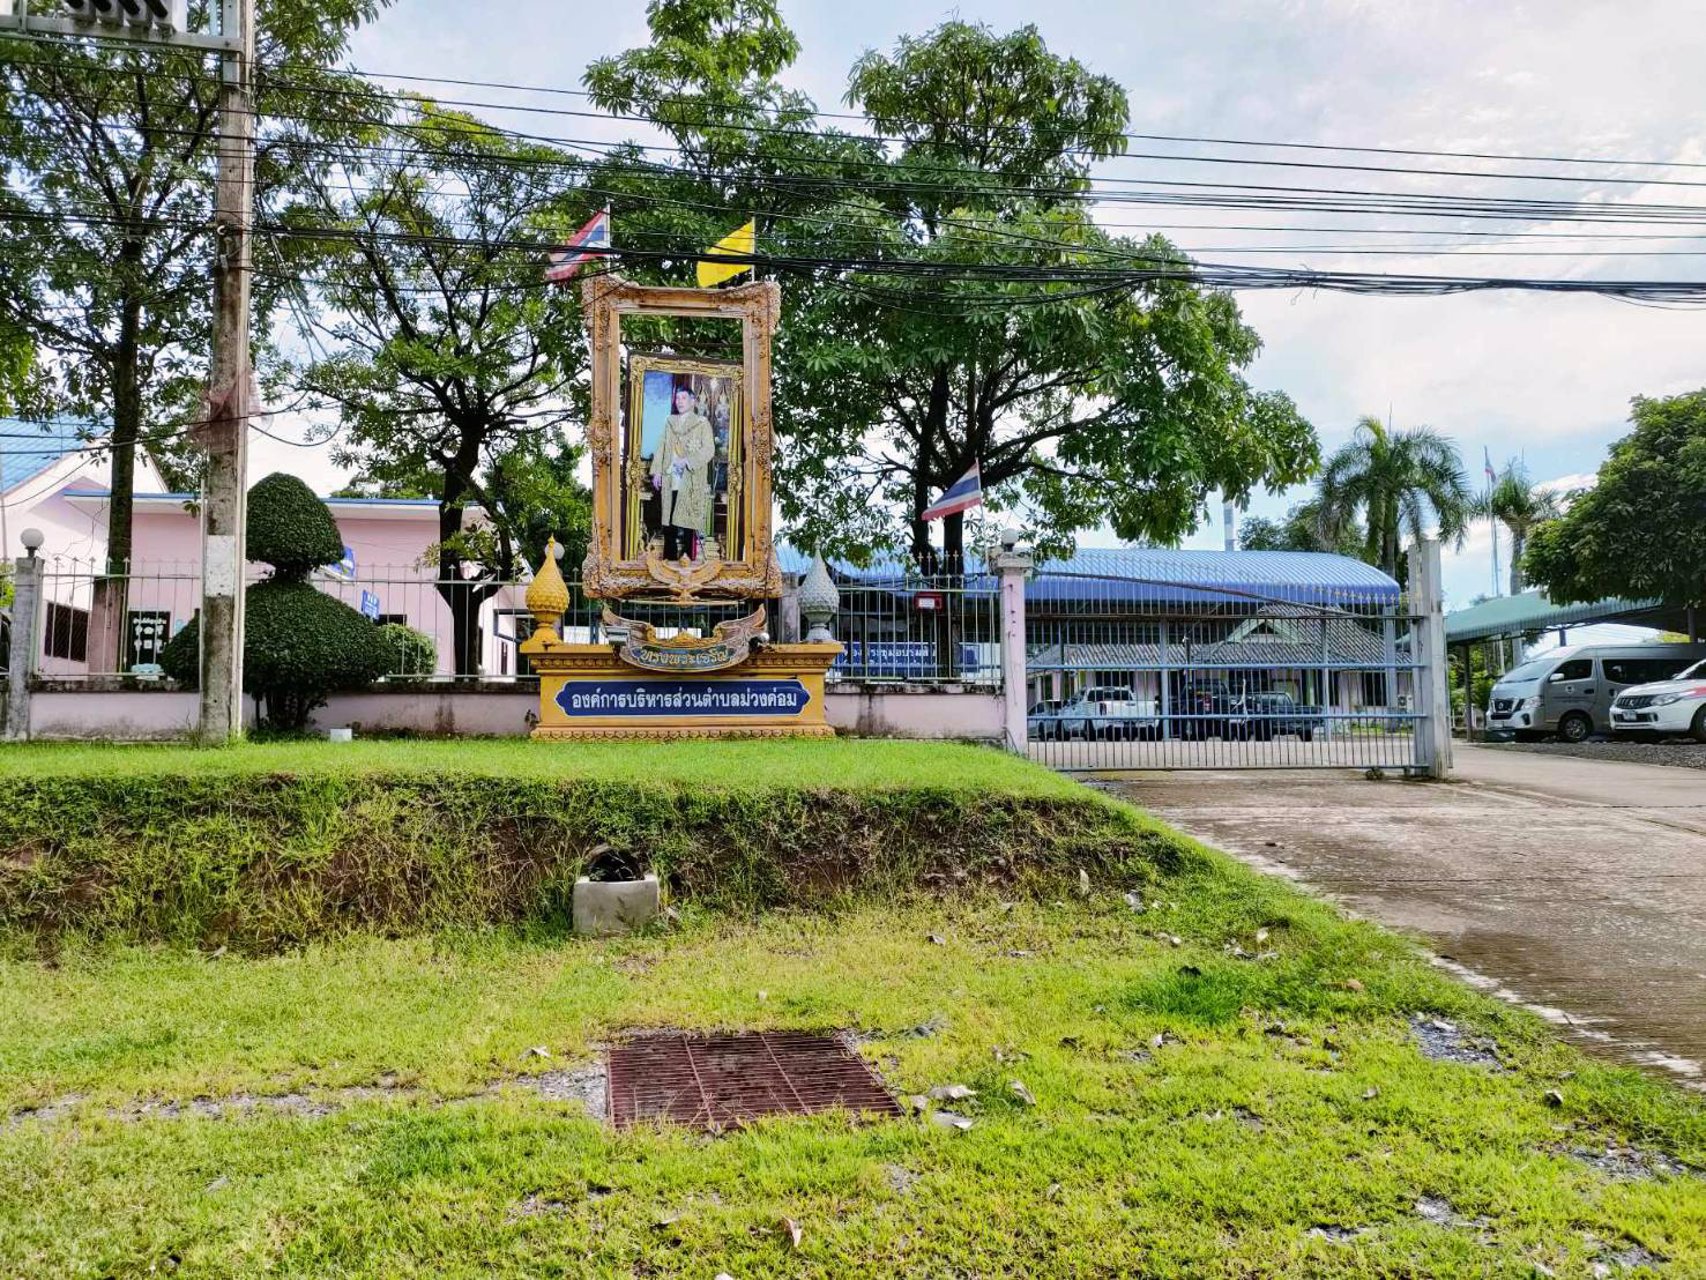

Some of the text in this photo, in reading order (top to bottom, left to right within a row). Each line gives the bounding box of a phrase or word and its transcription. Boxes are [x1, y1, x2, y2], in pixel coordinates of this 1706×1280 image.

[640, 648, 729, 665] ทรงพระเจริญ
[571, 687, 798, 709] องค์การบริหารส่วนตำบลม่วงค่อม
